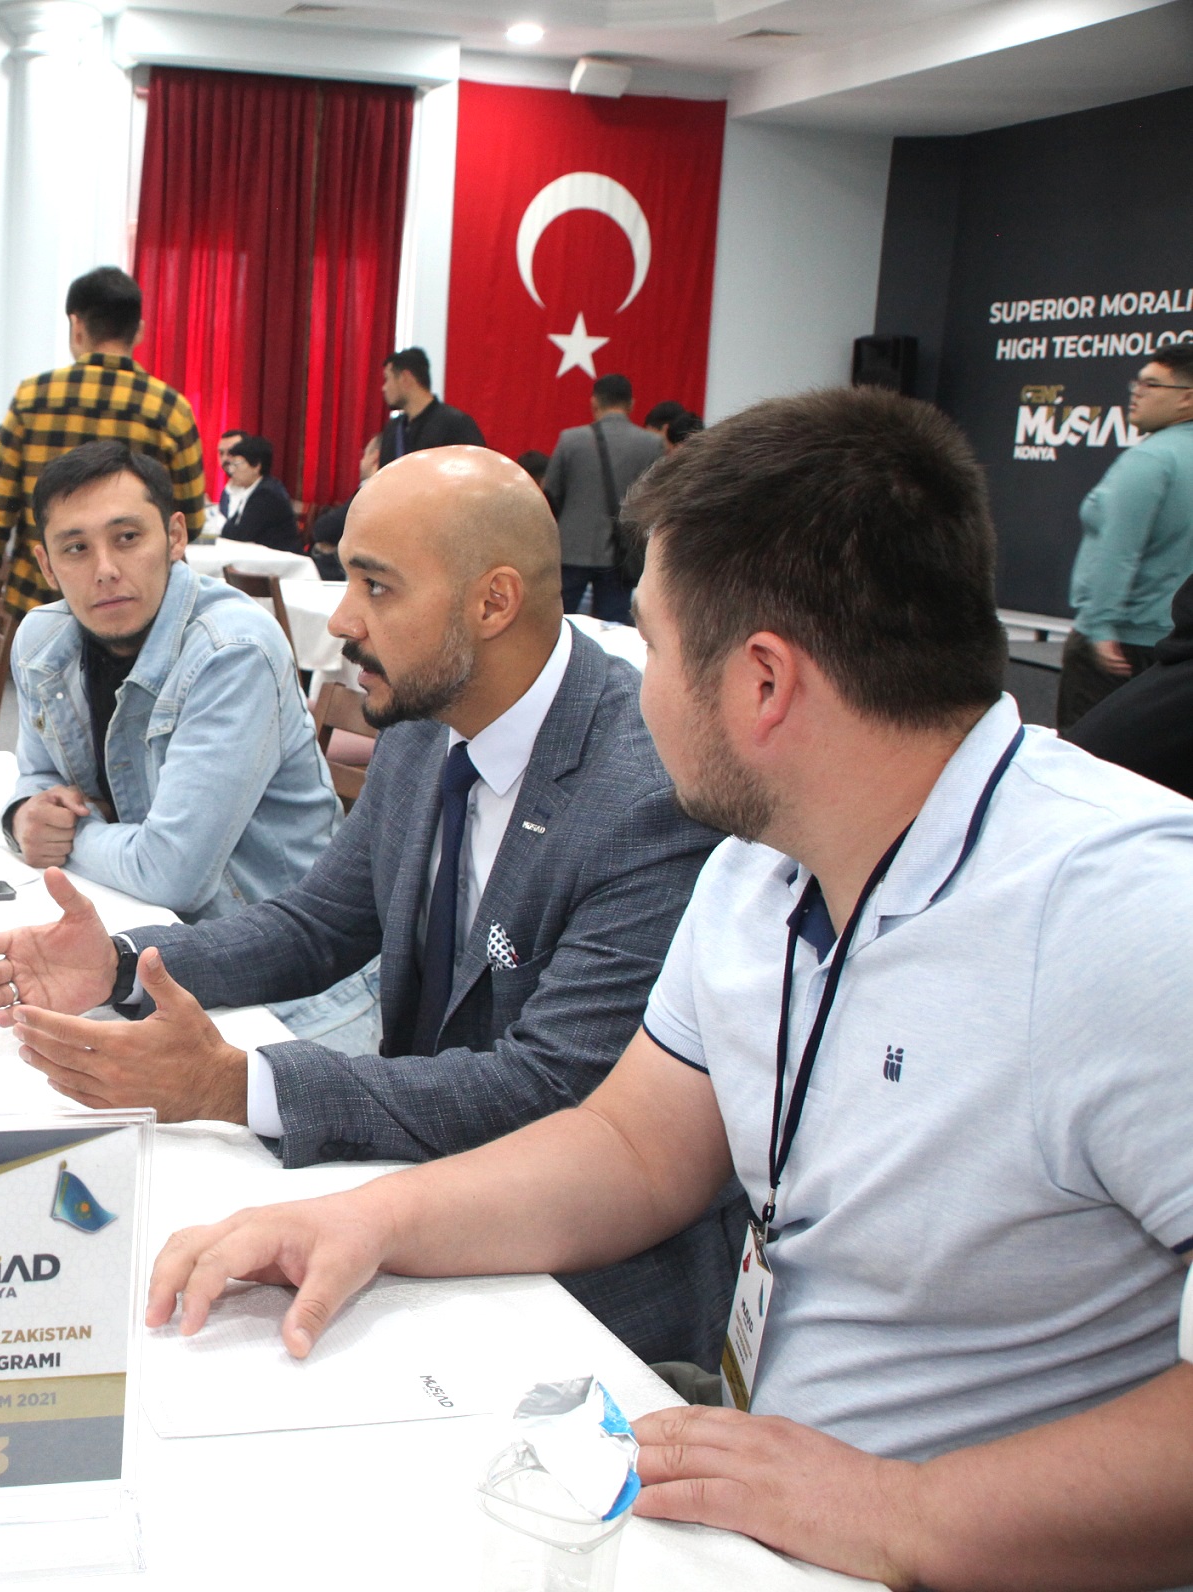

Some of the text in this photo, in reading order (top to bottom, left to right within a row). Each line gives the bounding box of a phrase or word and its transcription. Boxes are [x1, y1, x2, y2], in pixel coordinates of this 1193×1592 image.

[989, 296, 1095, 324] SUPERIOR
[996, 337, 1048, 360] HIGH
[1013, 445, 1057, 462] KONYA
[16, 1391, 57, 1408] 2021
